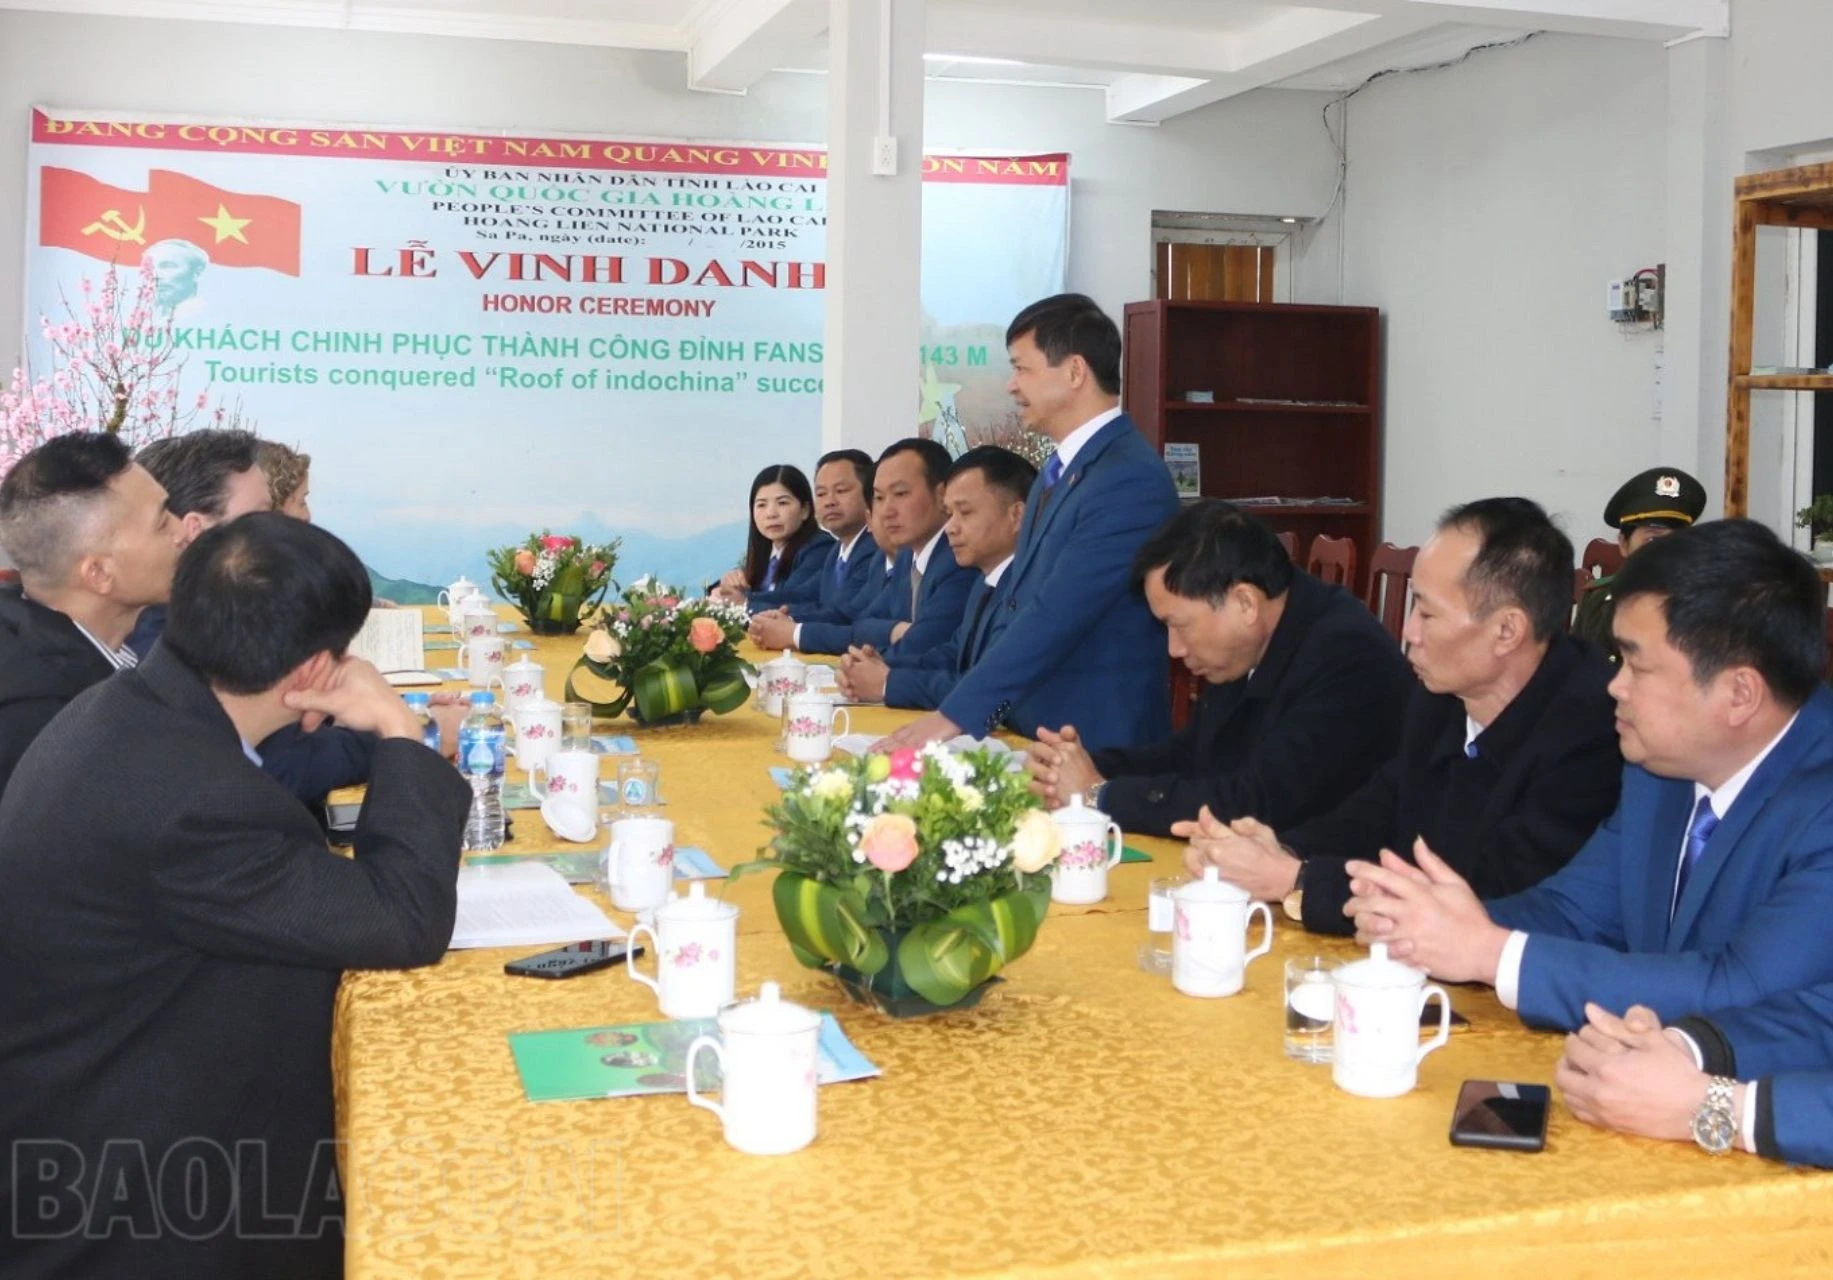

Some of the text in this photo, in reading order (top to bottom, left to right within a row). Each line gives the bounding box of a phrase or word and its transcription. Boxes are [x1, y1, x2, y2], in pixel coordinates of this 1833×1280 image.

[400, 135, 492, 157] VIỆT
[504, 139, 592, 159] NAM
[603, 144, 741, 166] QUANG
[376, 179, 478, 198] VƯỜN
[489, 183, 592, 203] QUỐC
[600, 189, 662, 206] GIA
[672, 190, 794, 211] HOÀNG
[484, 170, 531, 182] BAN
[537, 172, 603, 185] NHÂN
[610, 174, 657, 188] DÂN
[778, 181, 817, 193] CAI
[464, 216, 799, 238] HOANG LIEN NATIONAL PARK
[551, 206, 695, 222] COMMITTEE
[701, 211, 730, 223] OF
[737, 213, 784, 225] LAO
[476, 230, 498, 239] Sa
[539, 231, 582, 244] ngày
[353, 240, 827, 290] LỄ VINH DANH
[482, 293, 717, 318] HONOR CEREMONY
[175, 323, 281, 352] KHÁCH
[291, 330, 383, 354] CHINH
[392, 332, 473, 361] PHỤC
[482, 331, 580, 358] THÀNH
[589, 334, 671, 361] CÔNG
[679, 335, 745, 361] ĐỈNH
[967, 345, 988, 366] M
[205, 360, 319, 384] Tourists
[329, 365, 475, 391] conquered
[571, 368, 599, 391] of
